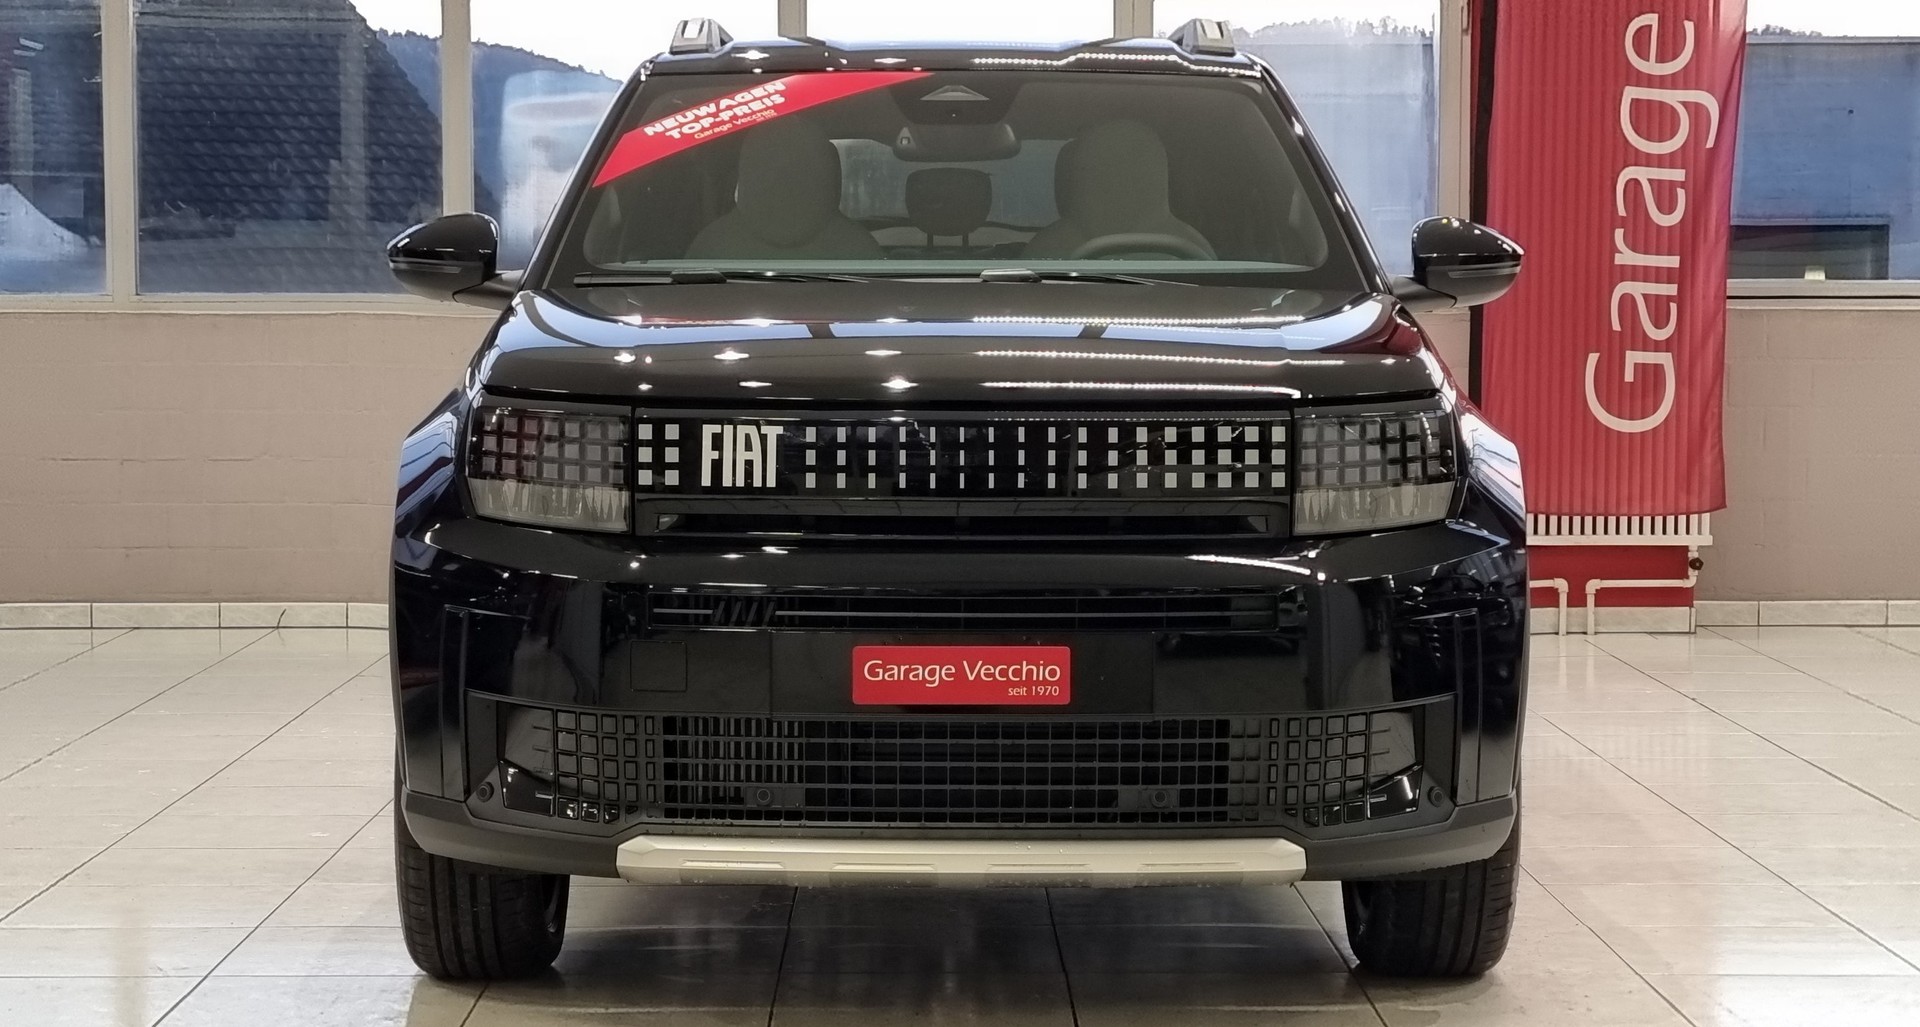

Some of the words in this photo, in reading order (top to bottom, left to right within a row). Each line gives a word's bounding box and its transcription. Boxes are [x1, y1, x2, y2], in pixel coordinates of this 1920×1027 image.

[643, 81, 786, 136] NEUWAGEN
[665, 94, 785, 139] TOP-PREIS
[694, 122, 733, 139] Garage
[732, 109, 775, 125] Vecchio
[1585, 13, 1719, 433] Garage
[701, 424, 784, 488] FIAT
[863, 660, 956, 688] Garage
[962, 660, 1061, 681] Vecchio
[1008, 685, 1028, 696] seit
[1031, 685, 1060, 696] 1970
